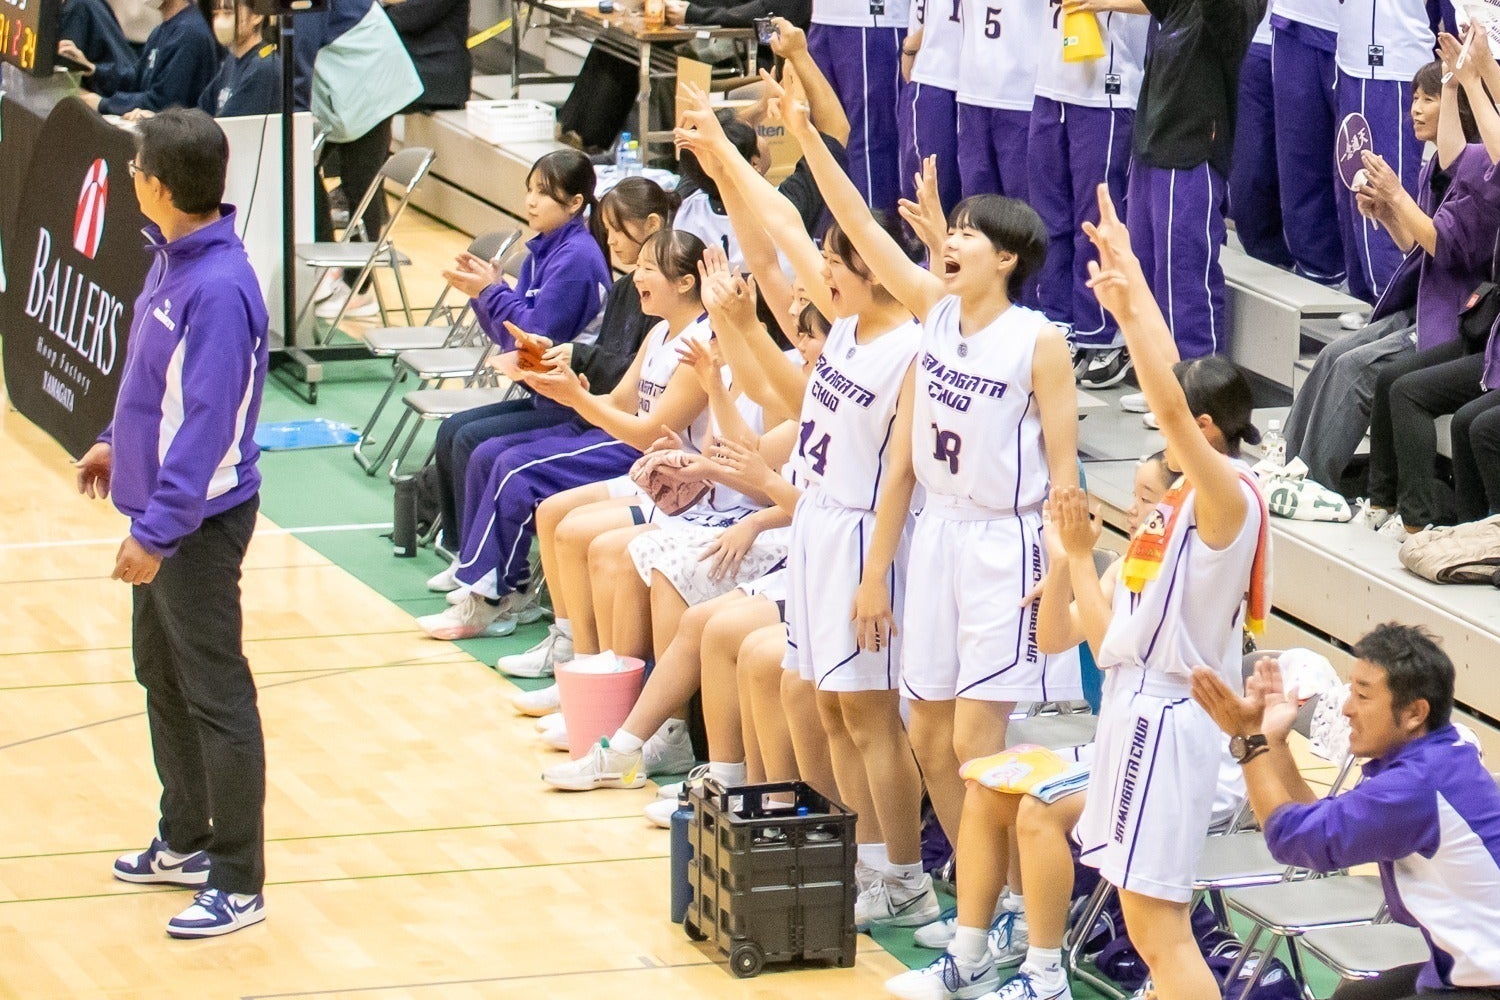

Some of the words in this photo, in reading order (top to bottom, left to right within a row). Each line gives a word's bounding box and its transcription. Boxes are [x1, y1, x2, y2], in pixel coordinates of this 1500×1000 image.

[984, 6, 1002, 39] 5
[757, 125, 785, 137] lten
[25, 226, 124, 376] BALLER'S
[36, 335, 57, 368] Hoop
[58, 353, 91, 396] Factory
[43, 371, 75, 413] YAMAGATA
[811, 380, 840, 413] CHUO
[928, 380, 972, 412] CHUO
[1114, 758, 1142, 844] YAMAGATA
[1129, 716, 1149, 757] CHUO
